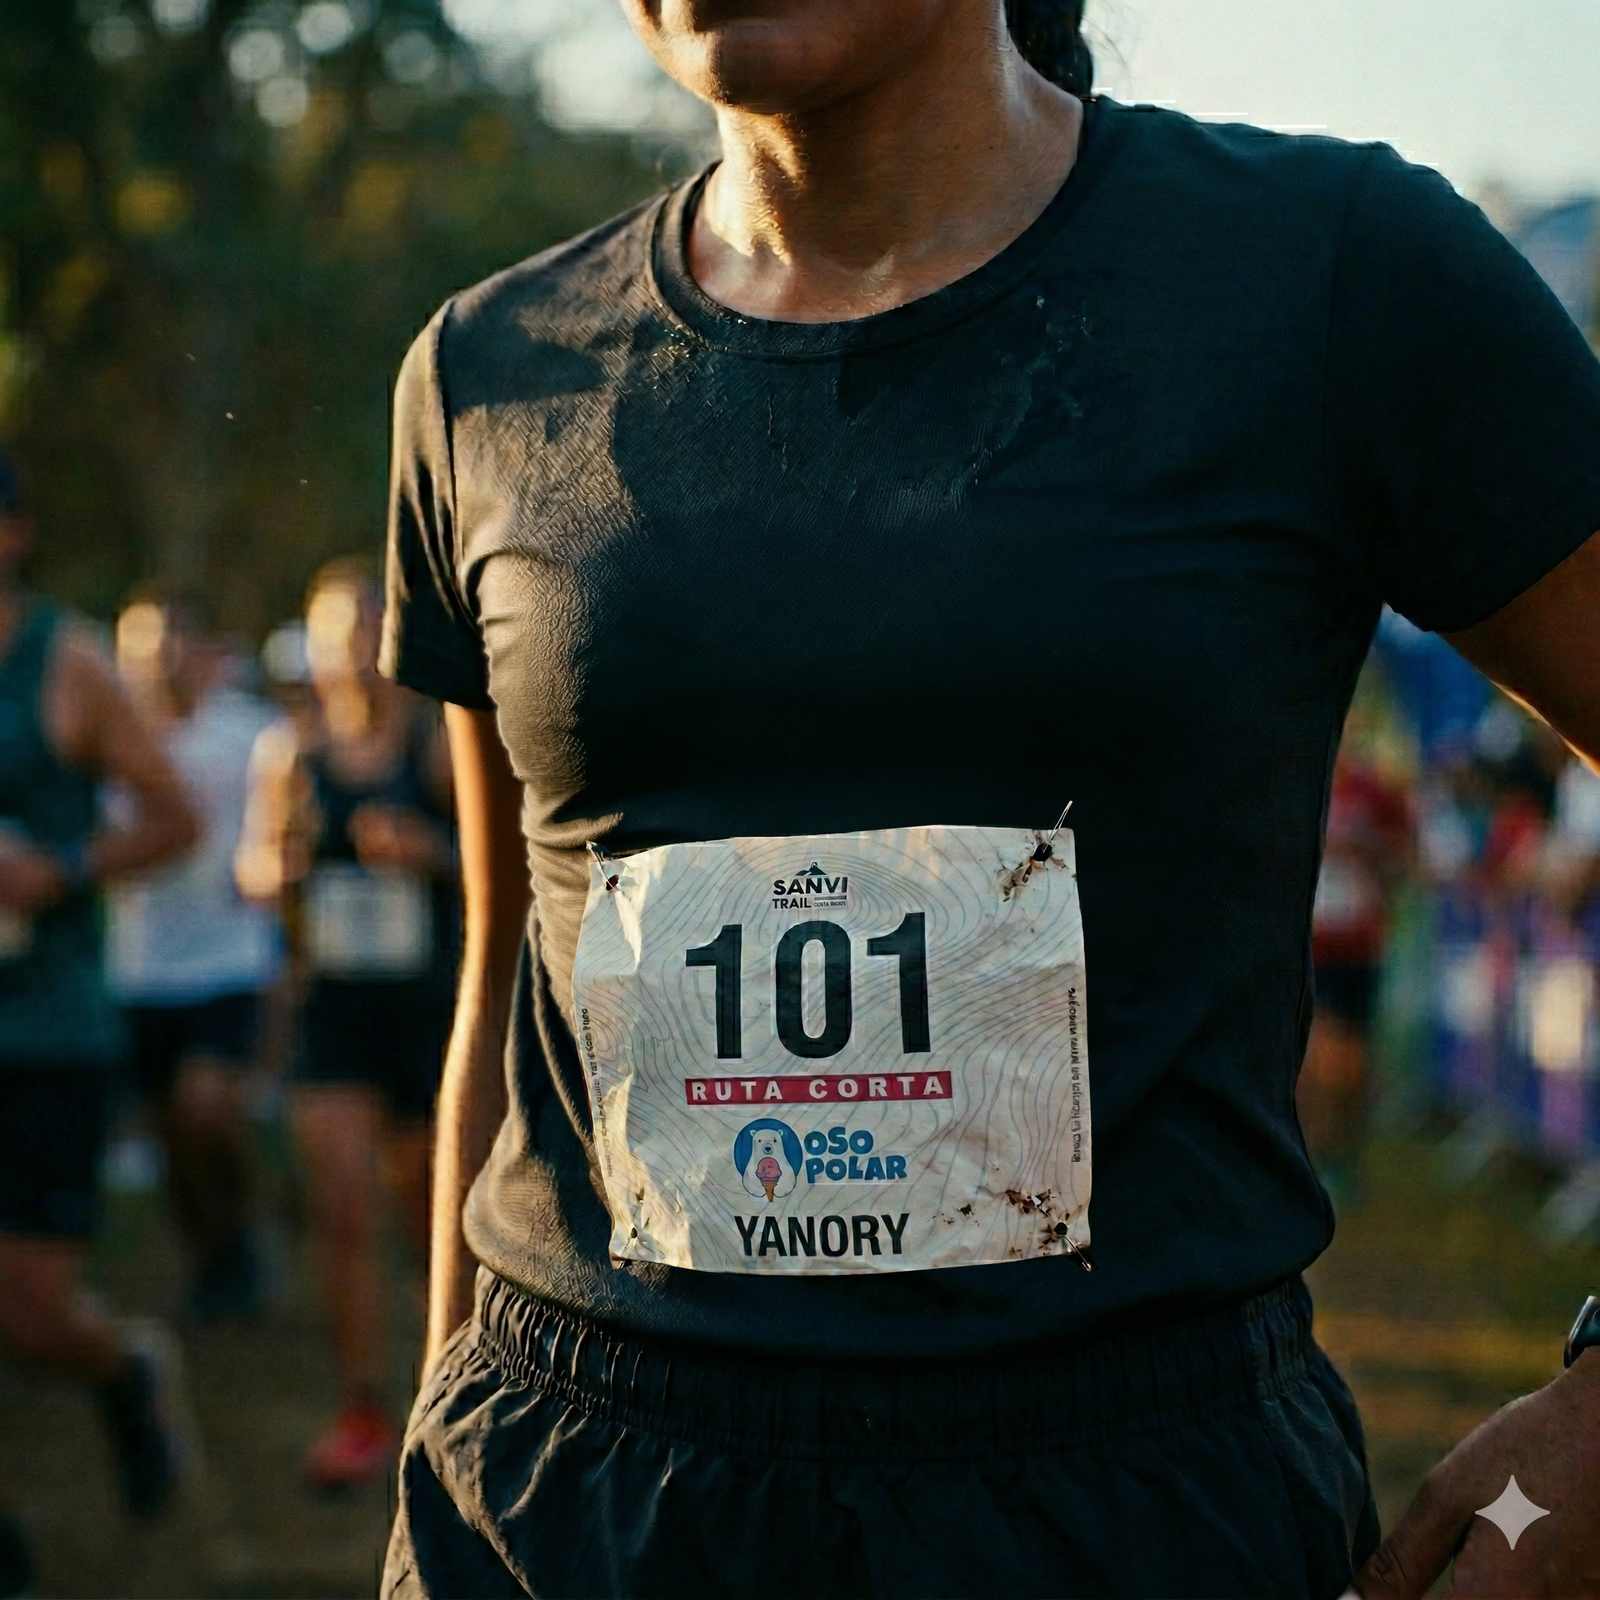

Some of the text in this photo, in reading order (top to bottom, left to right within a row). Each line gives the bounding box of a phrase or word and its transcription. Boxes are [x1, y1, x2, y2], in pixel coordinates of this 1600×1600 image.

[773, 876, 848, 896] SANVI
[772, 897, 812, 909] TRAIL
[686, 912, 931, 1059] 101
[692, 1076, 944, 1101] RUTA CORTA
[804, 1126, 874, 1156] OSO
[805, 1154, 908, 1184] POLAR
[734, 1212, 910, 1257] YANORY
